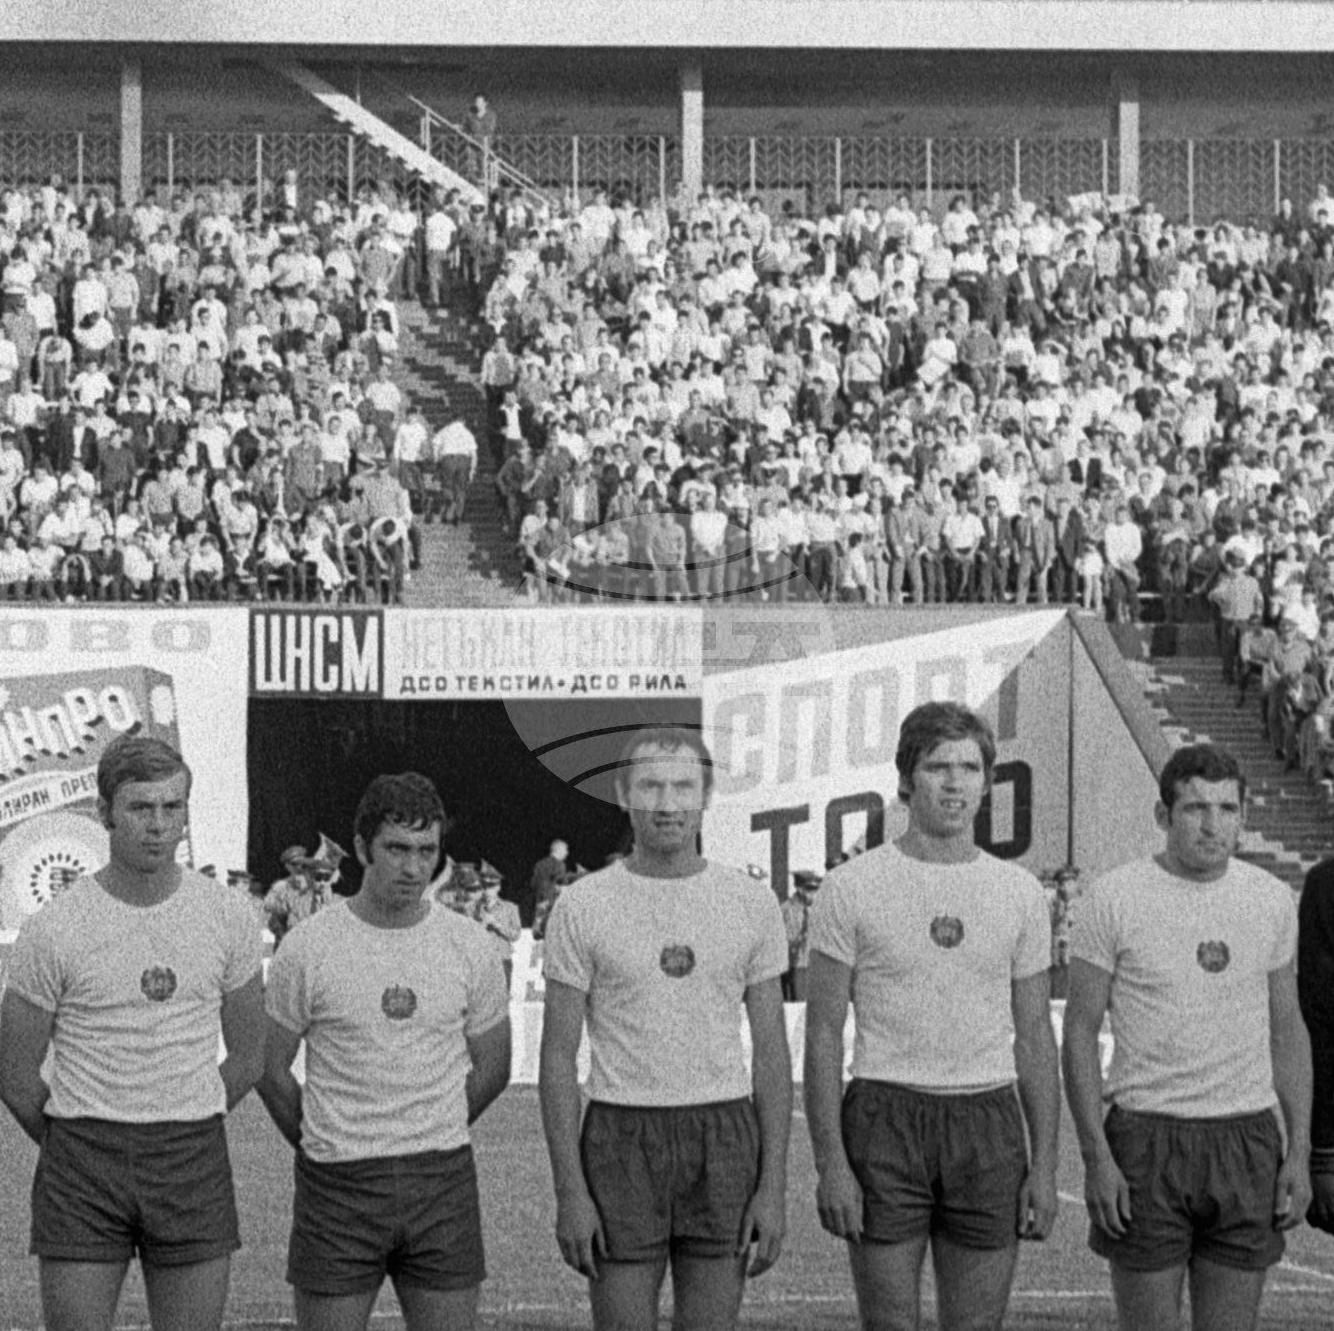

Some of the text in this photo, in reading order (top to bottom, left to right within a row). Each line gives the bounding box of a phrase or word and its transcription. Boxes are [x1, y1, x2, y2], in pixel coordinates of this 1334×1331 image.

[254, 614, 379, 692] ЦНСМ
[400, 673, 687, 695] ДСО ТЕКСТИЛ ДСО РИЛА
[750, 760, 1032, 905] ТОО
